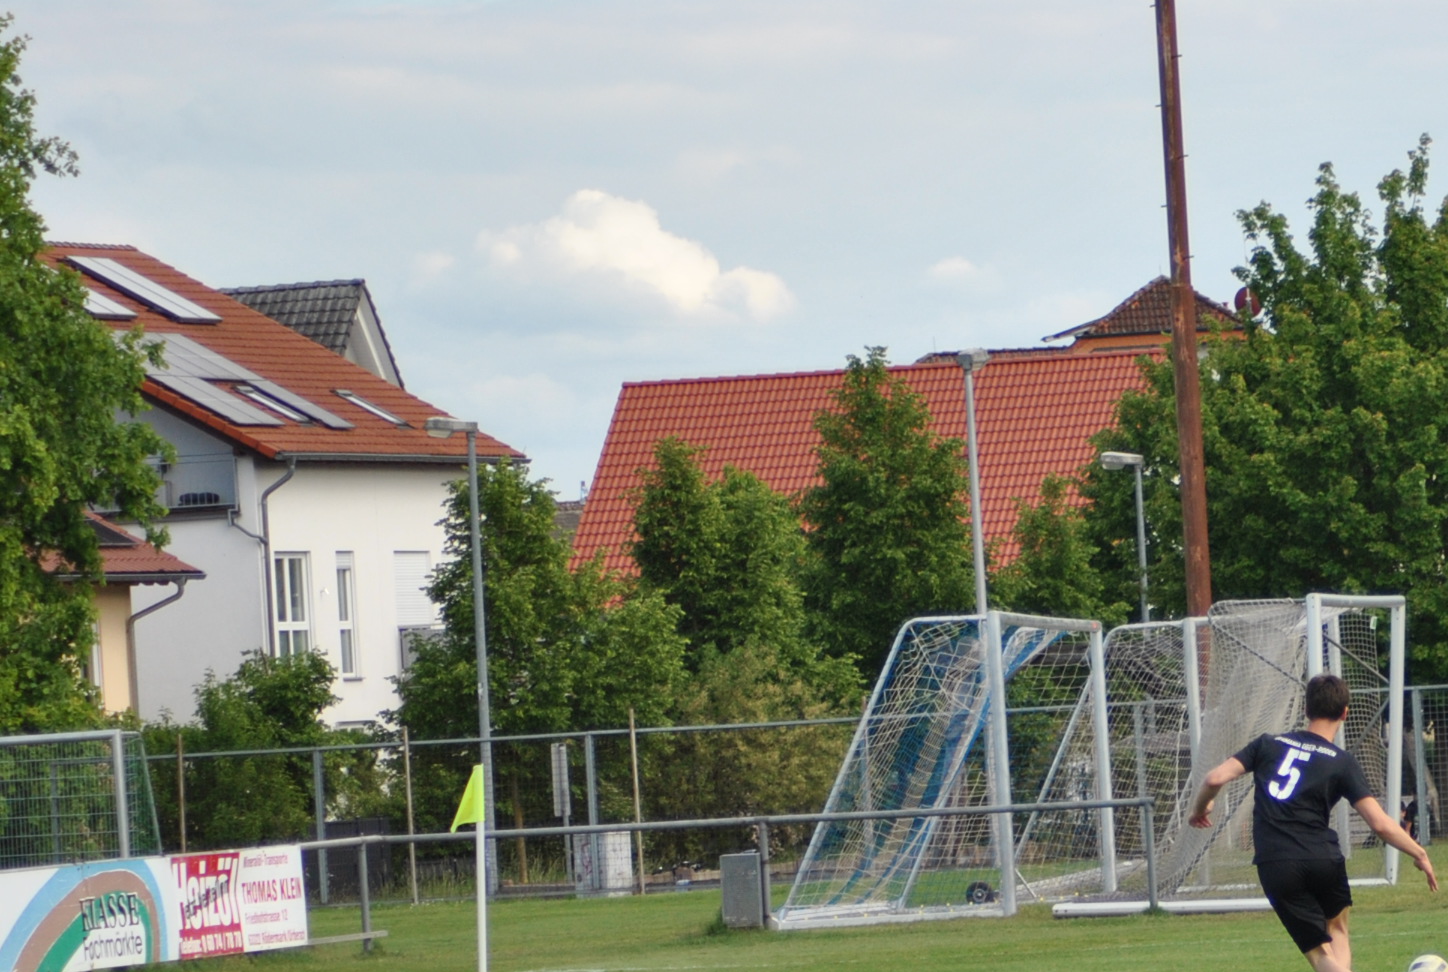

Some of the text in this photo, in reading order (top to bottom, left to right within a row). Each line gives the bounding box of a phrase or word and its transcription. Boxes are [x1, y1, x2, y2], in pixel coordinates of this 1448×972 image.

[1269, 747, 1312, 800] 5
[171, 857, 240, 930] Heizöl
[241, 879, 278, 905] THOMAS
[280, 877, 302, 901] KLEIN
[79, 892, 140, 932] KLASSE
[83, 931, 143, 960] Fachmärkte
